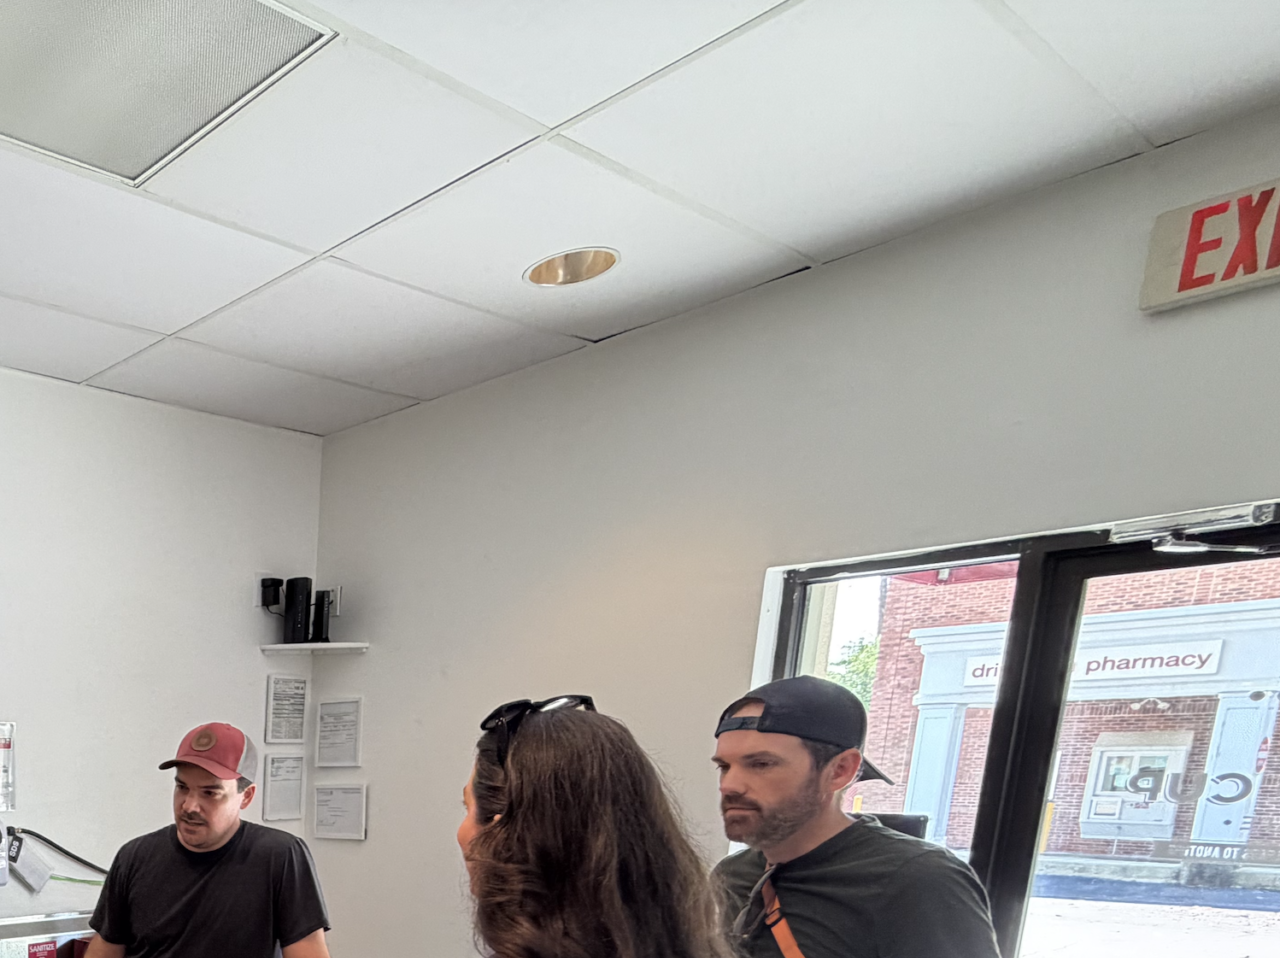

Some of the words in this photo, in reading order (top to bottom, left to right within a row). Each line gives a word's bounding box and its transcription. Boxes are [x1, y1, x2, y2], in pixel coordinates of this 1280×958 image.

[1085, 652, 1214, 676] pharmacy
[9, 840, 19, 857] SDS
[29, 943, 55, 953] SANITIZE
